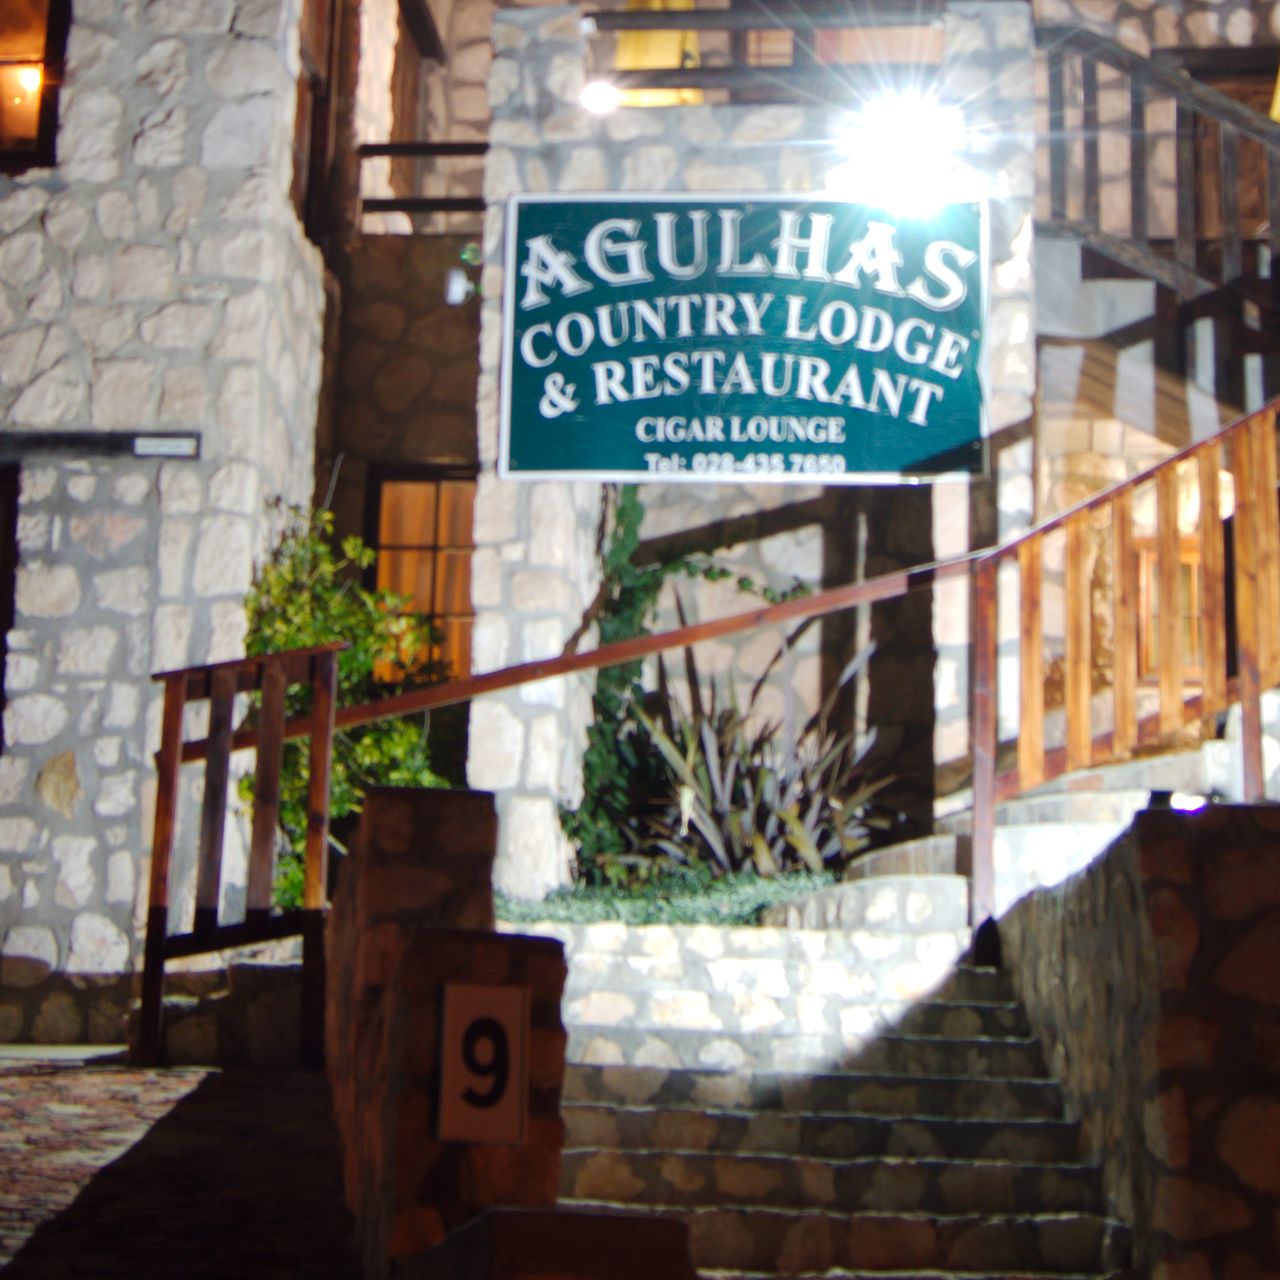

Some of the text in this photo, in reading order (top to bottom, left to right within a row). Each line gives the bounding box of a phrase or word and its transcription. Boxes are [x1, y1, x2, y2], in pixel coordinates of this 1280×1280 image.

[520, 208, 978, 312] AGULHAS
[520, 292, 970, 379] COUNTRY LODGE
[538, 350, 944, 426] & RESTAURANT
[635, 416, 846, 443] CIGAR LOUNGE
[461, 1017, 509, 1109] 9
